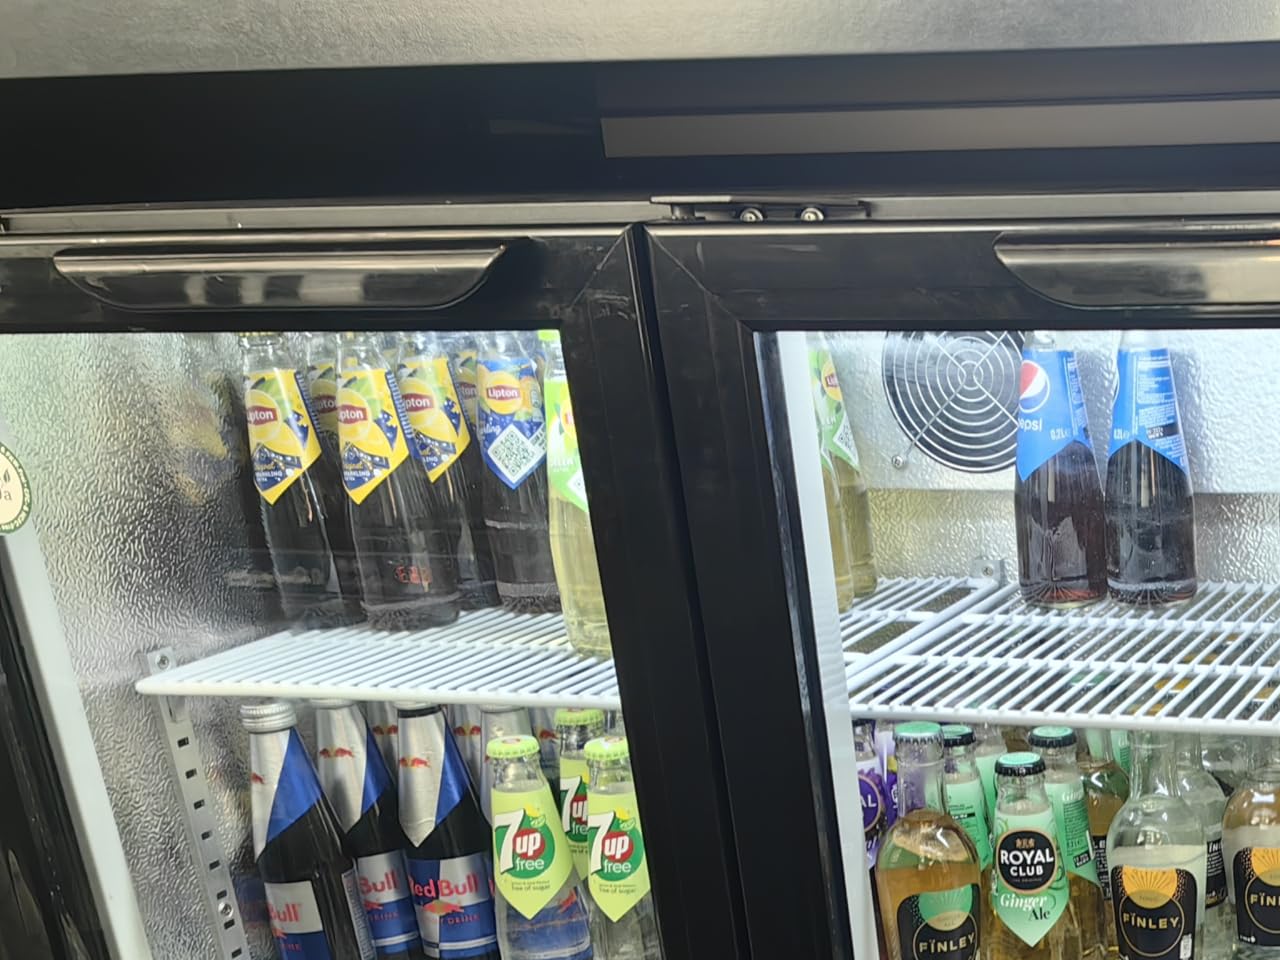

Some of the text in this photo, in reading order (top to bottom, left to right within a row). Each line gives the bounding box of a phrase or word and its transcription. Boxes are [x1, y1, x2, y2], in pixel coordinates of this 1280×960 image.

[488, 388, 518, 400] Lipton
[404, 397, 430, 409] pton
[247, 409, 274, 422] pton
[340, 409, 364, 422] pton
[572, 823, 588, 835] fre
[1000, 848, 1054, 865] ROYAL
[515, 859, 545, 871] free
[603, 860, 632, 873] free
[1010, 865, 1044, 876] CLUB
[1000, 893, 1048, 912] Ginger
[1030, 907, 1051, 921] Ale
